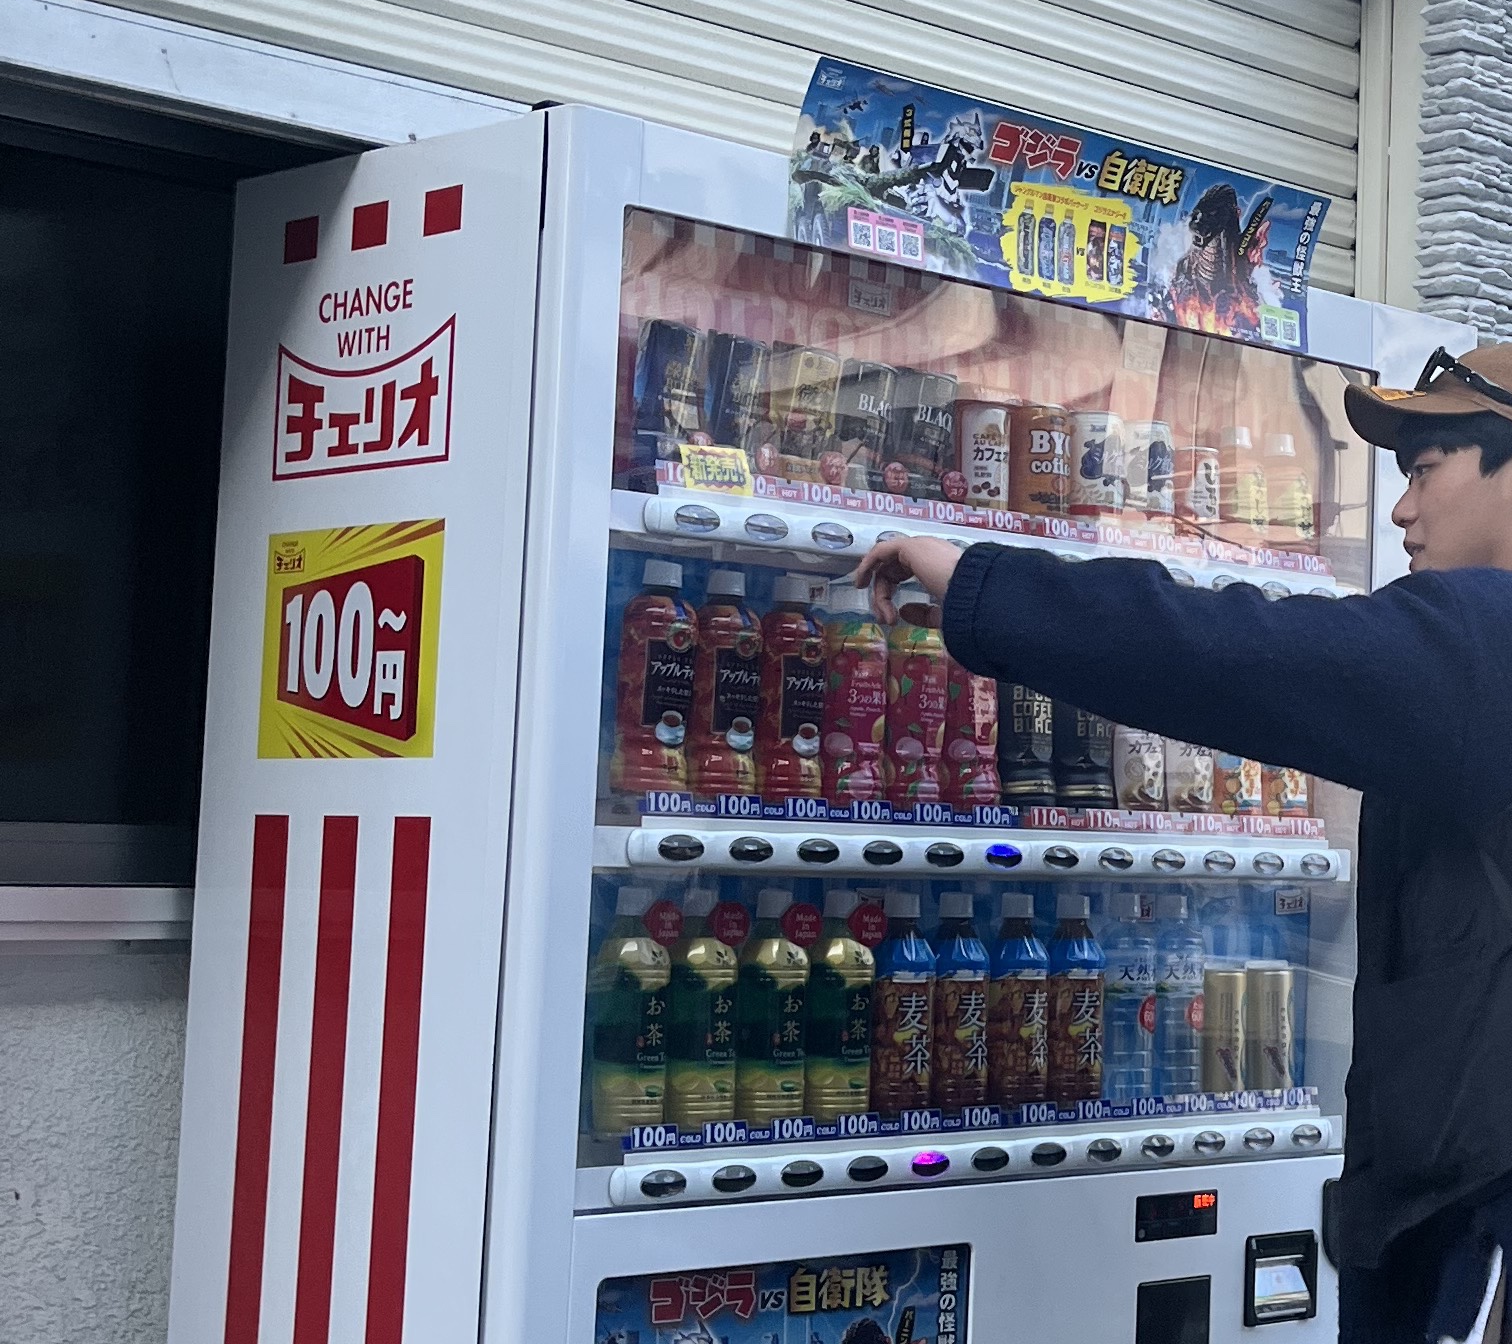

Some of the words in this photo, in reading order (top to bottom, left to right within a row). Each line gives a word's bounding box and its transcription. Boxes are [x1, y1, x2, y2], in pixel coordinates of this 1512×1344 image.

[990, 122, 1082, 180] ゴジラ
[1075, 160, 1099, 180] VS
[1098, 151, 1184, 204] 自衛隊
[318, 278, 413, 323] CHANGE
[337, 324, 390, 357] WITH
[284, 355, 440, 463] チェリオ
[858, 393, 893, 422] BLAC
[917, 404, 952, 433] BLAC
[689, 454, 746, 484] 新発売!
[781, 488, 798, 498] HOT
[802, 483, 842, 504] 100円
[866, 493, 904, 514] 100円
[928, 502, 964, 523] 100円
[986, 510, 1023, 531] 100円
[1044, 517, 1078, 538] 100円
[1098, 526, 1131, 545] 100円
[1150, 536, 1182, 552] 100円
[1296, 555, 1327, 572] 100円
[1013, 717, 1052, 734] BLAC
[1077, 722, 1112, 738] BLAC
[1128, 740, 1163, 755] カフェ
[649, 791, 692, 813] 100円
[694, 803, 716, 813] COLD
[718, 794, 761, 816] 100円
[763, 806, 784, 816] COLD
[787, 798, 827, 819] 100円
[829, 809, 850, 818] COLD
[852, 800, 891, 821] 100円
[893, 812, 912, 821] COLD
[915, 803, 952, 823] 100円
[954, 814, 973, 823] COLD
[974, 806, 1010, 825] 100円
[1033, 808, 1067, 826] 110円
[1088, 810, 1121, 828] 110円
[1142, 812, 1173, 830] 110円
[1192, 815, 1223, 832] 110円
[1243, 817, 1272, 833] 110円
[1290, 819, 1319, 835] 110円
[657, 929, 680, 941] Japan
[723, 929, 745, 939] Japan
[795, 930, 817, 939] Japan
[861, 931, 882, 940] Japan
[1119, 962, 1156, 982] 天然
[1164, 961, 1199, 982] 天然
[646, 995, 666, 1047] お茶
[713, 995, 733, 1044] お茶
[782, 994, 803, 1043] お茶
[850, 993, 870, 1041] お茶
[898, 992, 932, 1075] 麦茶
[959, 990, 988, 1071] 麦茶
[1024, 988, 1049, 1071] 麦茶
[1072, 988, 1103, 1067] 麦茶
[633, 1126, 676, 1147] 100円
[679, 1134, 701, 1144] COLD
[705, 1122, 746, 1143] 100円
[750, 1130, 770, 1140] COLD
[773, 1118, 813, 1139] 100円
[816, 1125, 837, 1135] COLD
[839, 1114, 878, 1135] 100円
[881, 1121, 900, 1131] COLD
[903, 1110, 940, 1131] 100円
[942, 1118, 961, 1128] COLD
[963, 1106, 1000, 1127] 100円
[1021, 1102, 1056, 1123] 100円
[1058, 1110, 1076, 1120] COLD
[1078, 1100, 1111, 1119] 100円
[1113, 1107, 1130, 1117] COLD
[1132, 1097, 1164, 1116] 100円
[1183, 1094, 1214, 1112] 100円
[1234, 1091, 1264, 1109] 100円
[1281, 1088, 1311, 1106] 100円
[650, 1271, 756, 1323] ゴジラ
[759, 1290, 786, 1311] VS
[789, 1265, 890, 1313] 自衛隊
